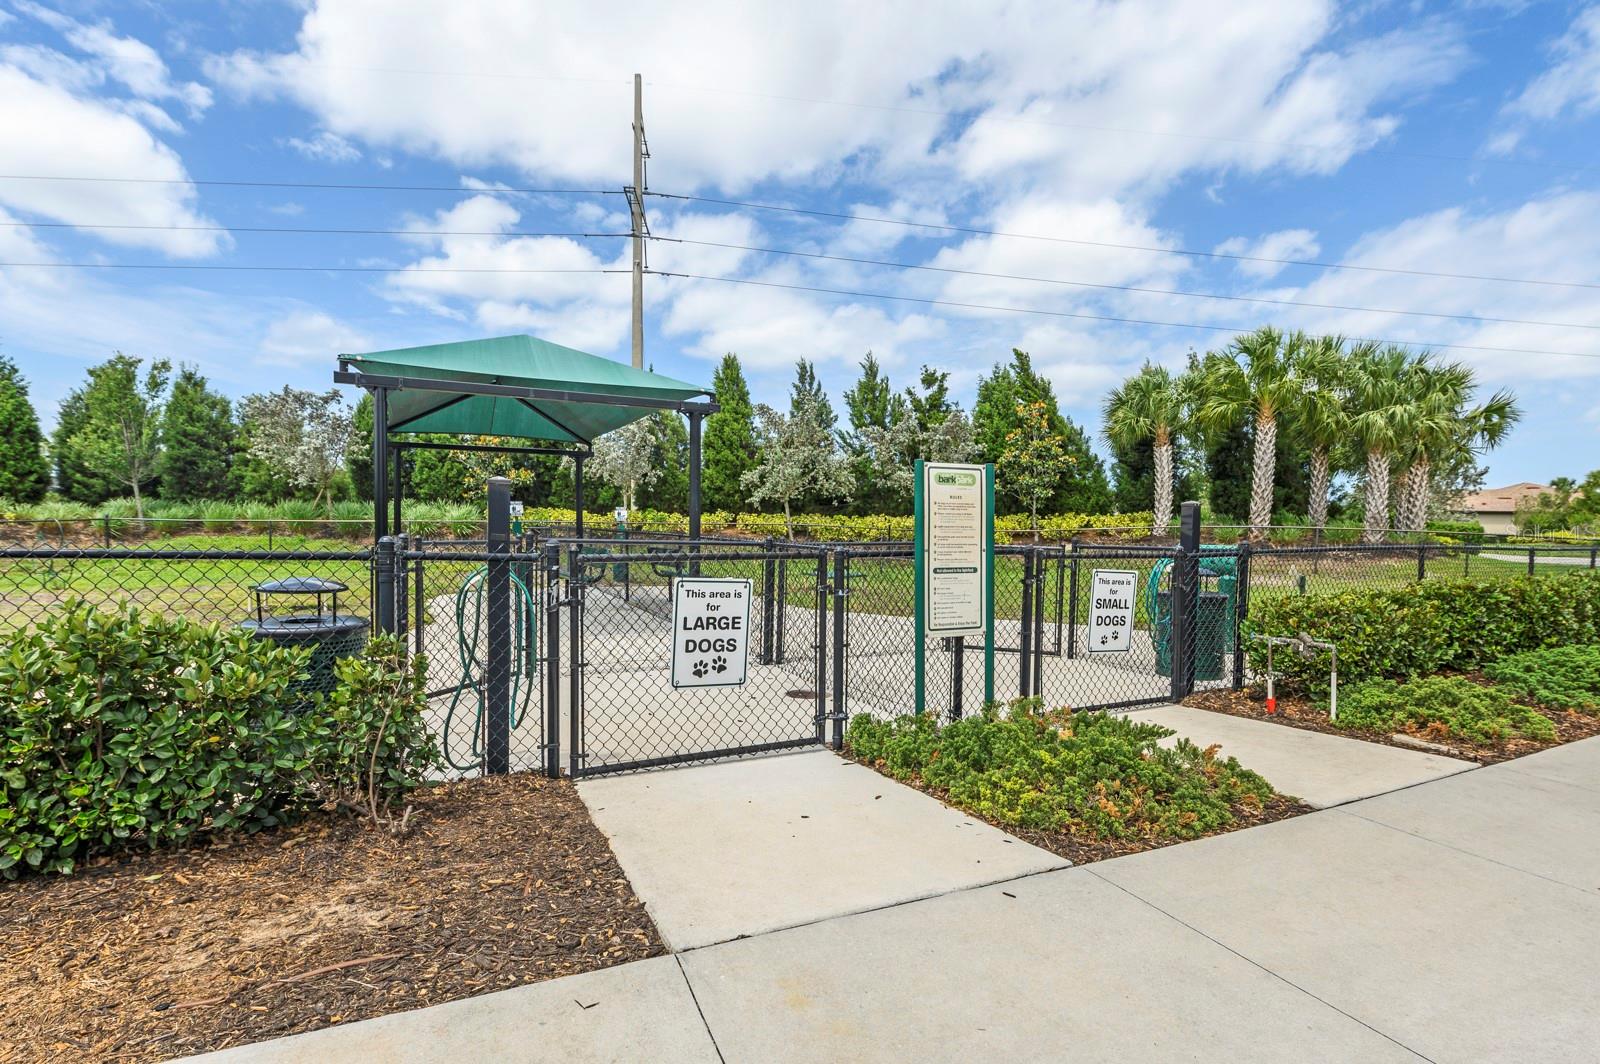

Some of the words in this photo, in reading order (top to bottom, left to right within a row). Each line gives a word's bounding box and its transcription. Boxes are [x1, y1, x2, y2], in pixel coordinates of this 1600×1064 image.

[1125, 578, 1131, 586] is
[685, 589, 706, 598] This
[709, 591, 731, 599] area
[734, 589, 742, 599] is
[706, 602, 721, 611] for
[1095, 598, 1130, 610] SMALL
[683, 616, 742, 630] LARGE
[1096, 615, 1126, 626] DOGS
[685, 638, 737, 653] DOGS
